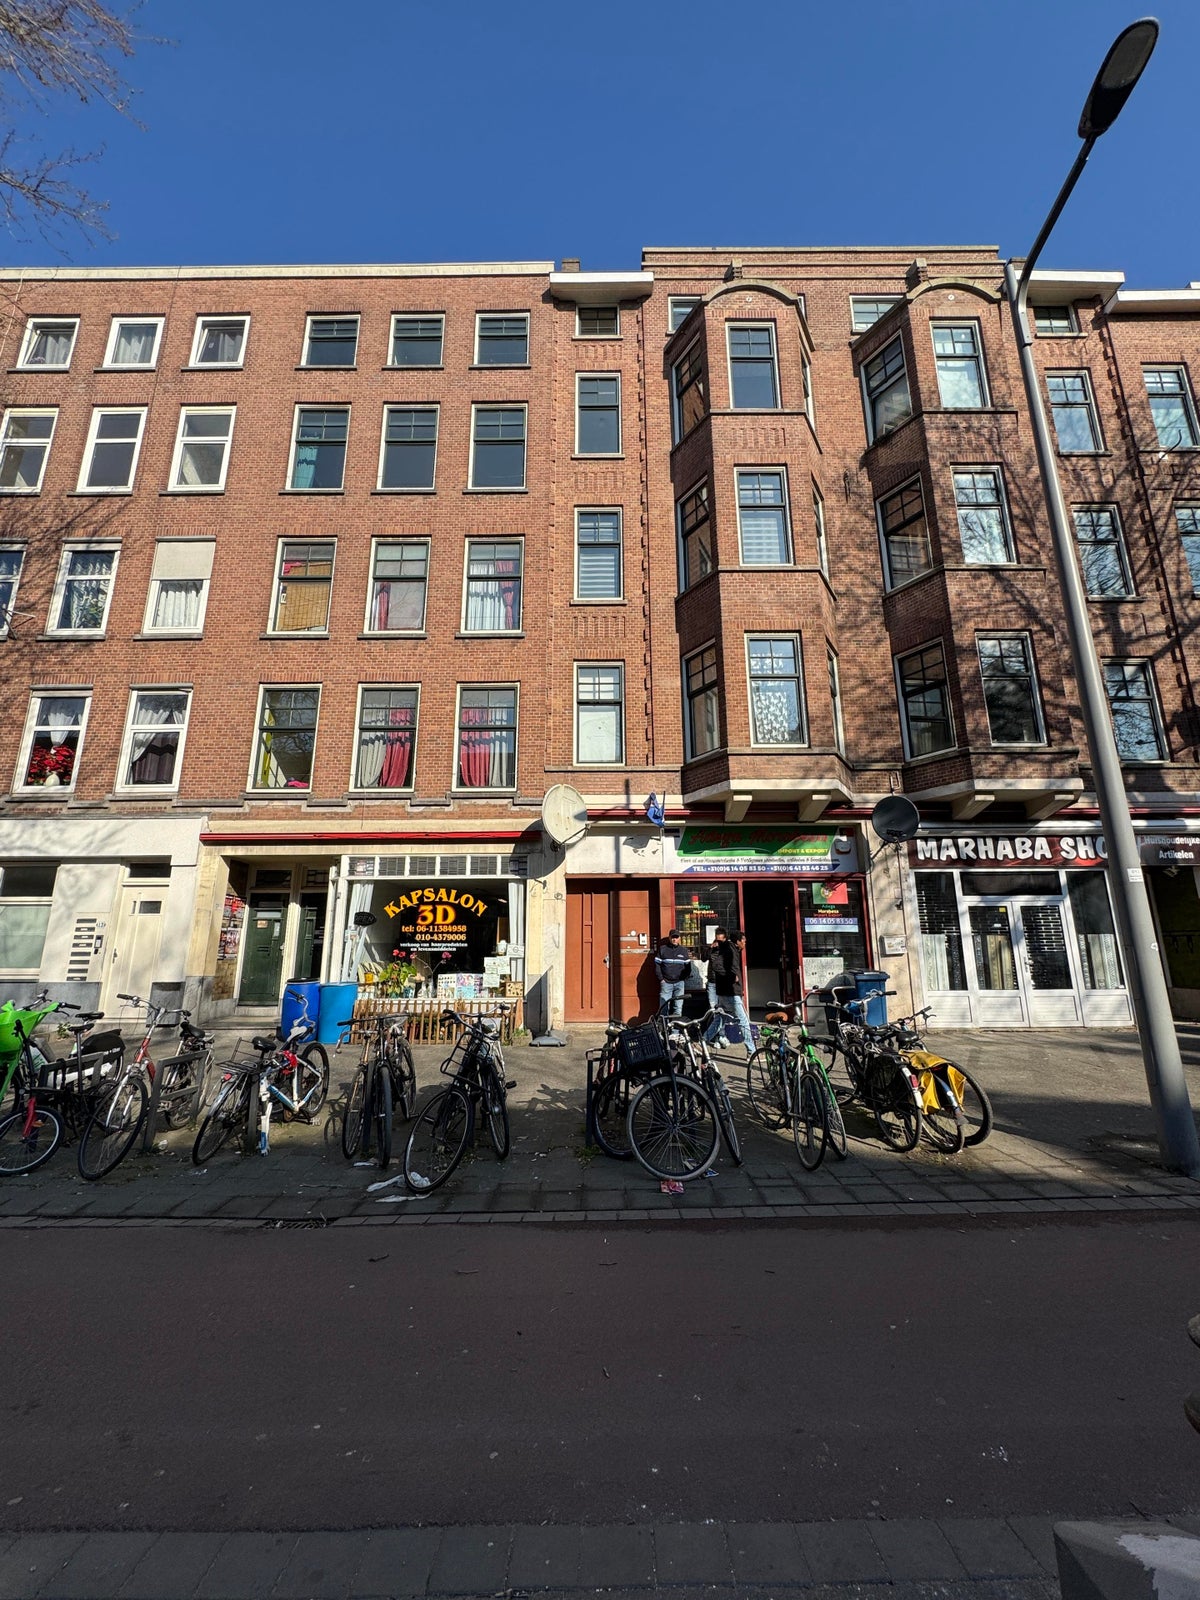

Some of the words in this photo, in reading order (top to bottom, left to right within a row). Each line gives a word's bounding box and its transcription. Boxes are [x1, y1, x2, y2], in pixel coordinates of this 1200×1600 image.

[916, 837, 1053, 861] MARHABA
[1158, 850, 1194, 859] Artikelen
[383, 887, 488, 919] KAPSALON
[416, 904, 456, 926] 3D
[401, 925, 415, 933] tel:
